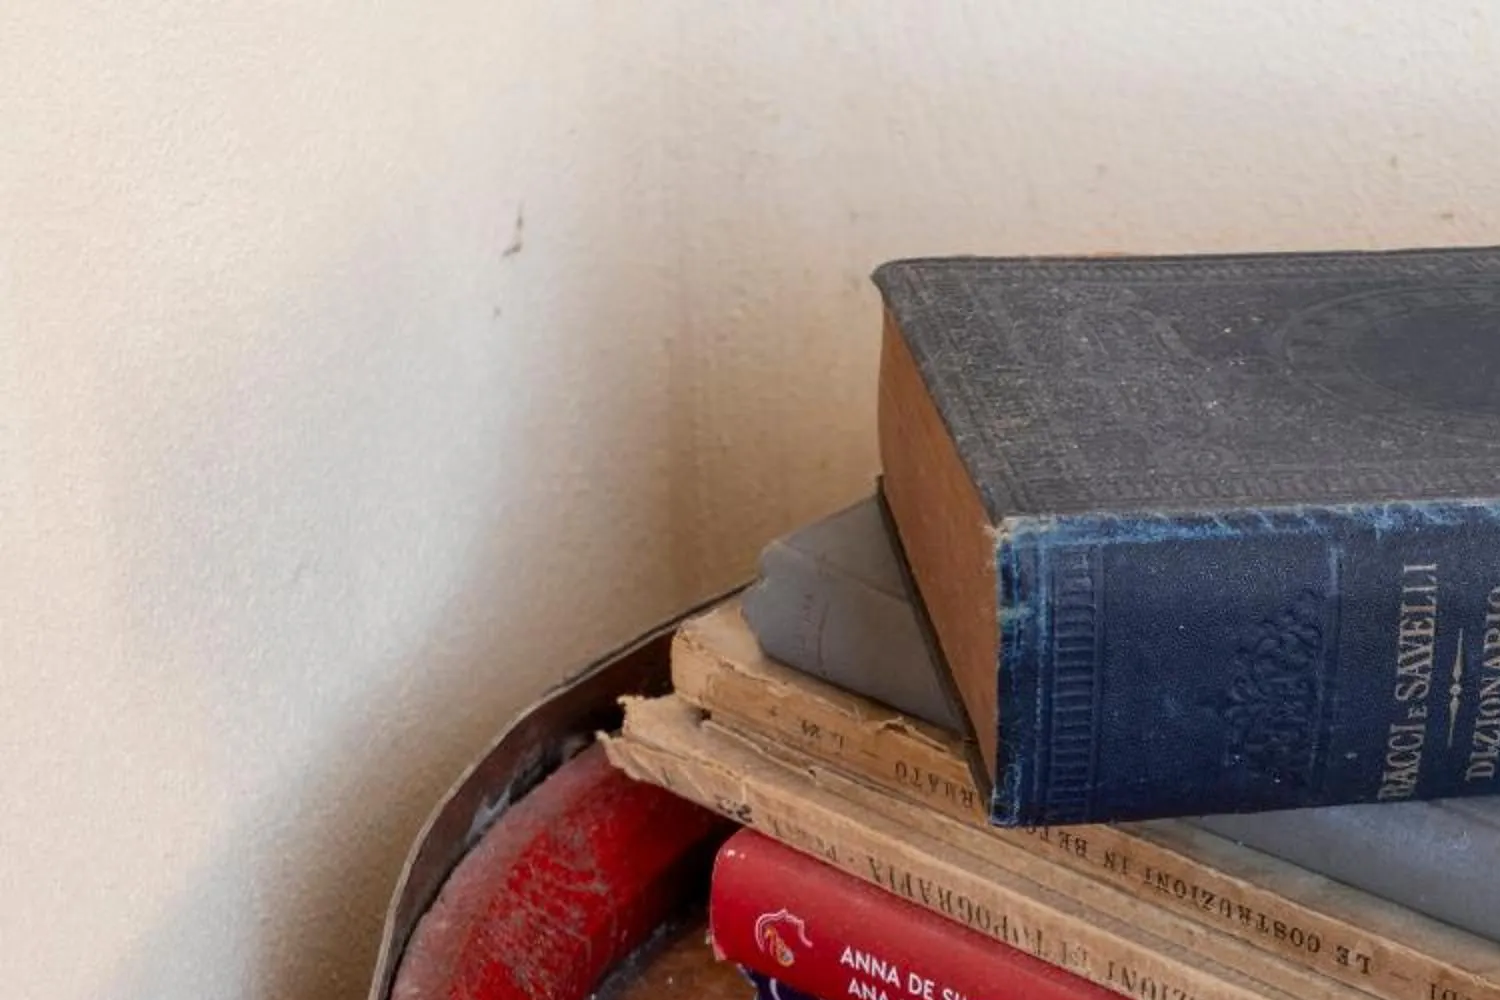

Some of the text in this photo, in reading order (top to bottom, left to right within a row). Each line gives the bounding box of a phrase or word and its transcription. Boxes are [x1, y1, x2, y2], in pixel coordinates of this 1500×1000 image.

[1394, 563, 1438, 702] SAVELLI
[1104, 851, 1128, 875] IN
[1143, 868, 1321, 953] COSTRUZIONI
[840, 946, 901, 988] ANNA
[1337, 946, 1372, 974] LE
